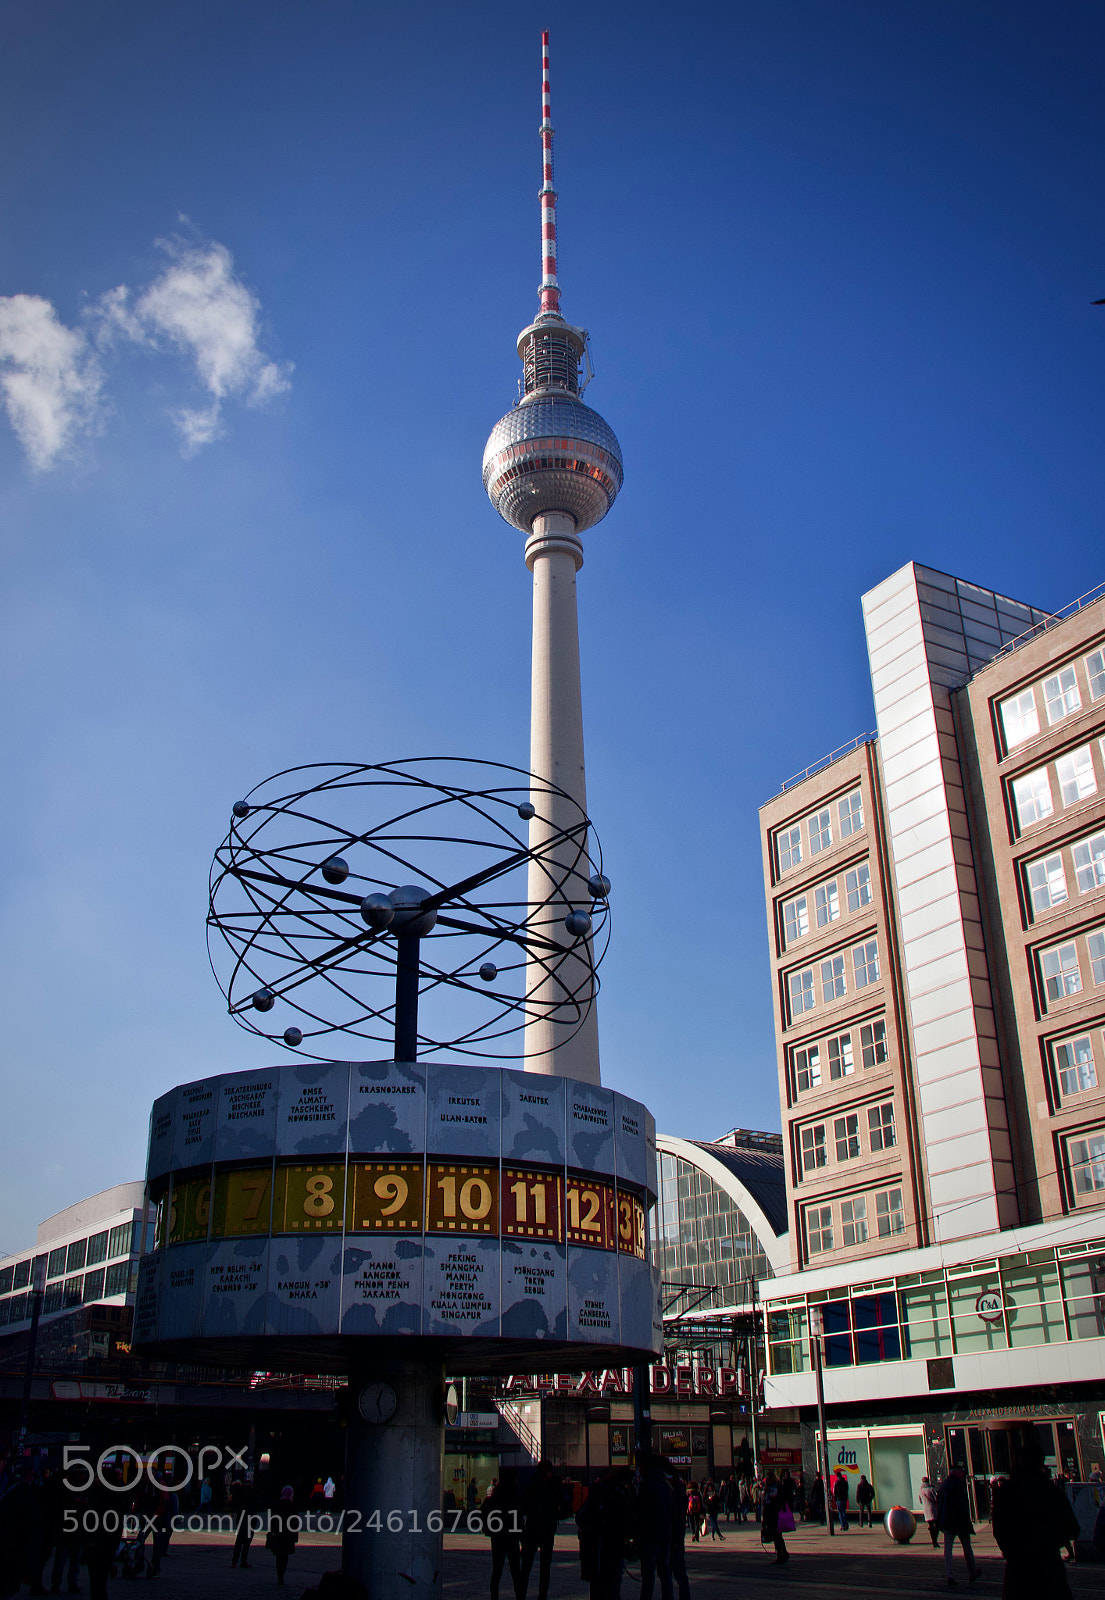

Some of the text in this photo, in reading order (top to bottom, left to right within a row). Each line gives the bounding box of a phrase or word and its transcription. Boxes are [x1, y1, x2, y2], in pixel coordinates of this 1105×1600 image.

[224, 1082, 272, 1095] JEKATERINBURG
[303, 1087, 323, 1096] OMSK
[359, 1086, 416, 1094] KRASNOJARSK
[229, 1091, 266, 1104] ASCHGABAT
[298, 1095, 327, 1105] ALMATY
[448, 1096, 481, 1107] IRKUTSK
[519, 1094, 549, 1105] JAKUTSK
[291, 1104, 334, 1114] TASCHKENT
[288, 1113, 336, 1122] NOWOSIBIRSK
[440, 1113, 488, 1124] ULAN-BATOR
[242, 1177, 269, 1220] 7
[303, 1174, 335, 1217] 8
[373, 1174, 408, 1217] 9
[437, 1176, 492, 1220] 10
[510, 1181, 546, 1224] 11
[566, 1188, 601, 1232] 12
[448, 1254, 476, 1263] PEKING
[210, 1265, 224, 1275] NEW
[227, 1264, 246, 1274] DELHI
[369, 1262, 396, 1270] HANOI
[440, 1263, 484, 1272] SHANGHAI
[220, 1273, 251, 1283] KARACHI
[363, 1271, 401, 1280] BANGKOK
[446, 1273, 478, 1282] MANILA
[278, 1281, 310, 1290] RANGUN
[354, 1281, 410, 1289] PHNOM PENH
[524, 1276, 545, 1286] TOKYO
[212, 1284, 241, 1293] COLOMBO
[449, 1282, 474, 1291] PERTH
[524, 1286, 546, 1295] SEOUL
[289, 1290, 317, 1299] DHAKA
[362, 1290, 401, 1299] JAKARTA
[440, 1291, 484, 1300] HONGKONG
[431, 1300, 492, 1311] KUALA LUMPUR
[584, 1300, 605, 1310] SYDNEY
[981, 1299, 999, 1311] C&A
[441, 1310, 481, 1320] SINGAPUR
[579, 1308, 610, 1319] CANBERRA
[578, 1317, 611, 1329] MELBOURNE
[838, 1446, 857, 1465] dm
